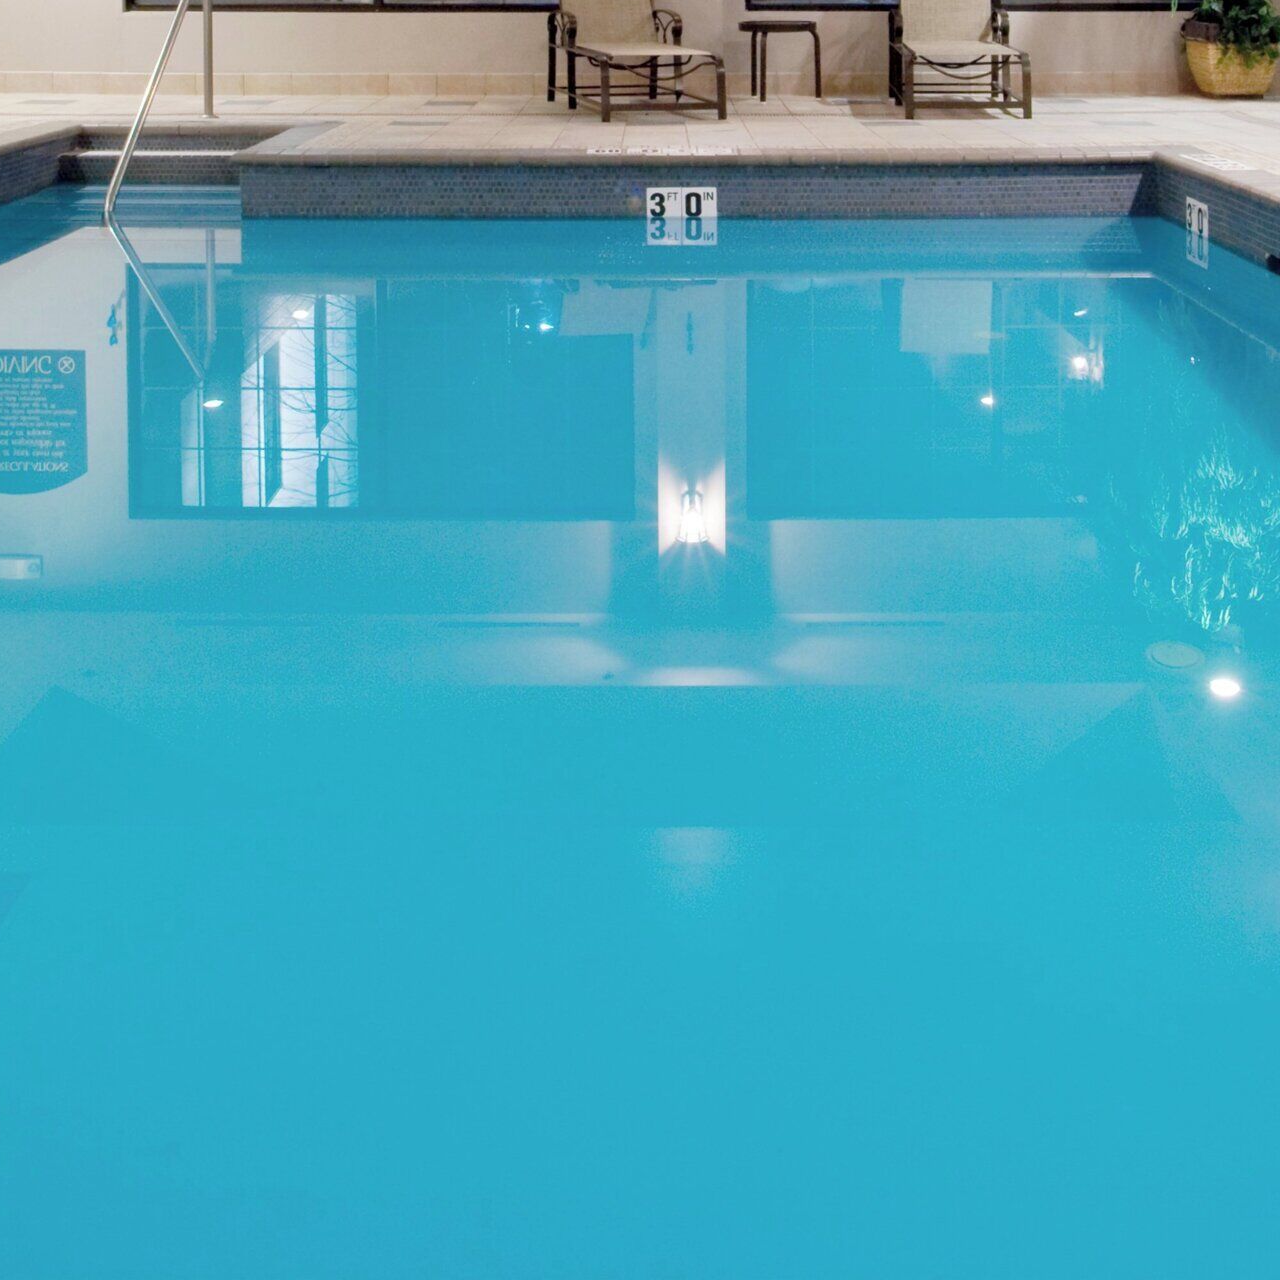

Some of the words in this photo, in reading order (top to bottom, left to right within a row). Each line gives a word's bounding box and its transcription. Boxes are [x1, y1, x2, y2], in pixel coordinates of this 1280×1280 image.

[650, 192, 666, 217] 3
[667, 192, 679, 201] FT
[685, 192, 702, 217] 0
[703, 192, 714, 201] IN
[1187, 202, 1193, 228] 3
[1197, 207, 1204, 234] 0
